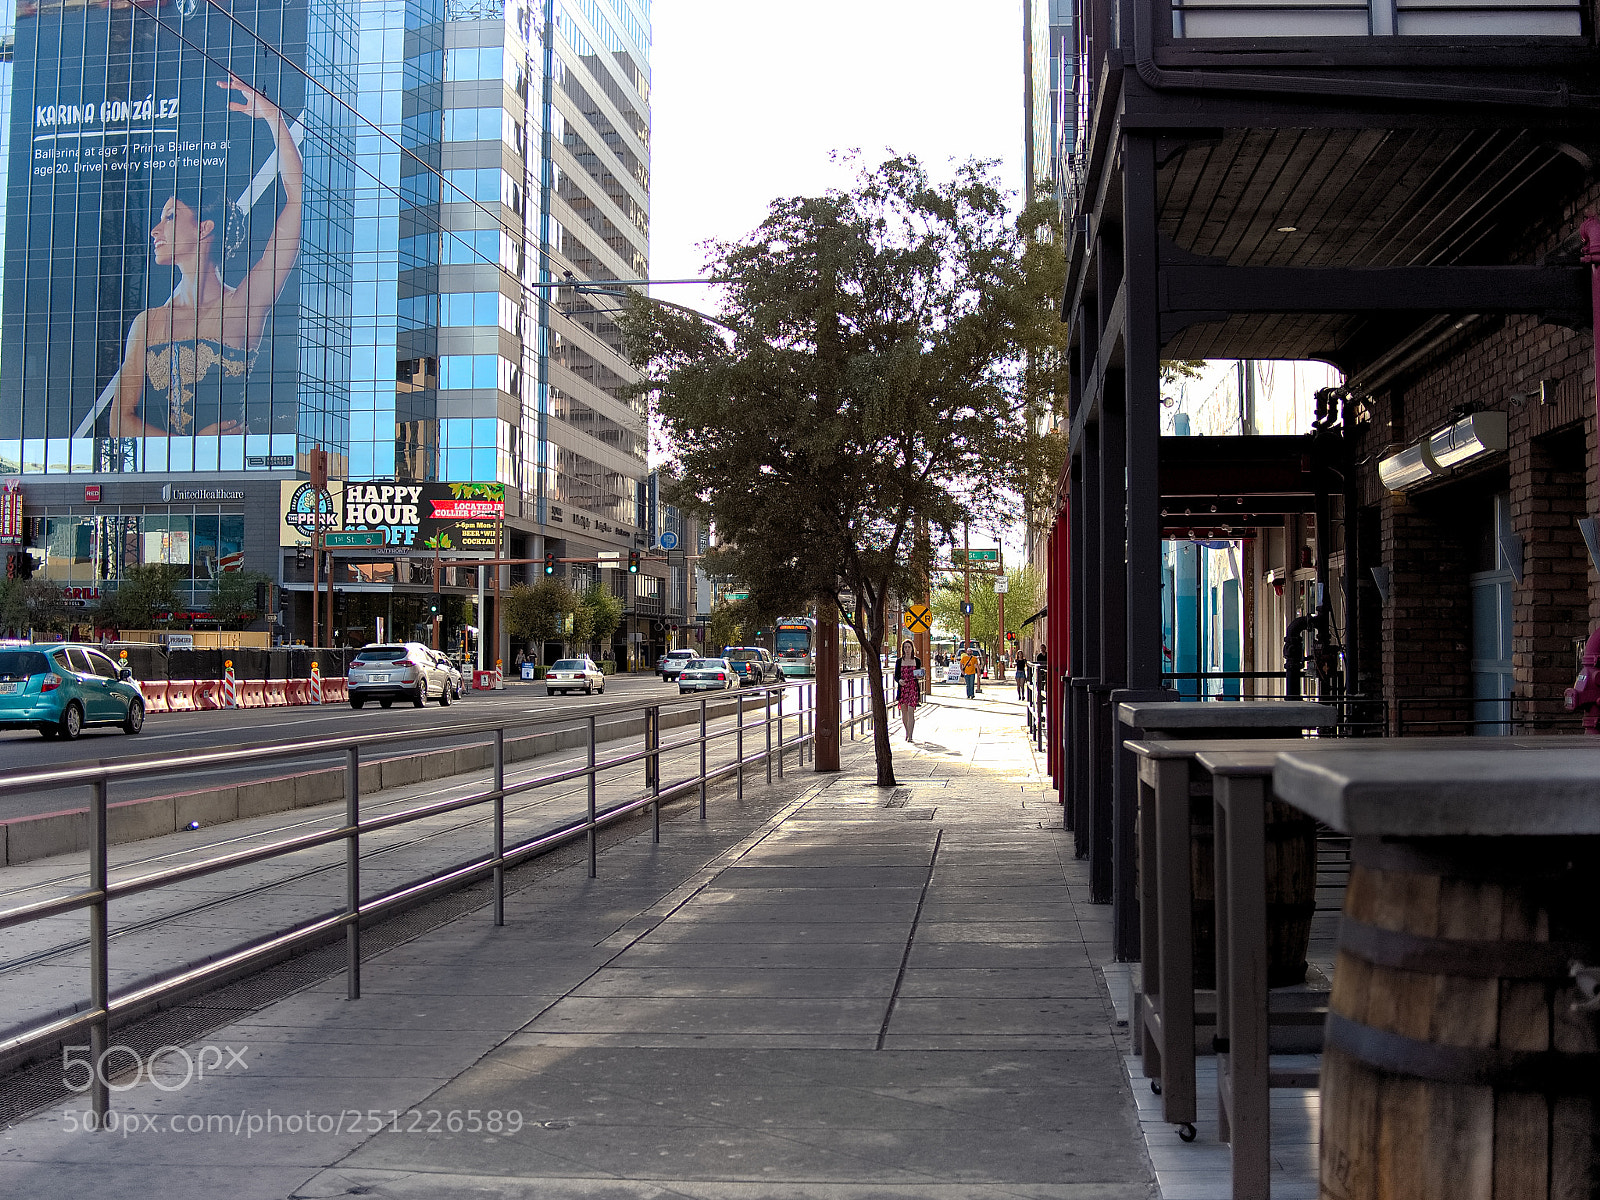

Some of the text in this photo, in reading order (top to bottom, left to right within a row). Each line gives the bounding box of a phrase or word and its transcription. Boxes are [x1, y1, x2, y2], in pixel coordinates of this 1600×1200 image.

[36, 103, 95, 128] KARINA
[35, 148, 80, 159] Ballerina
[84, 147, 95, 157] at
[98, 147, 118, 157] age
[133, 143, 165, 154] Prima
[168, 141, 217, 152] Ballerna
[220, 139, 231, 150] at
[34, 166, 53, 176] age
[55, 163, 71, 174] 20.
[74, 162, 108, 172] Driven
[110, 159, 141, 172] every
[183, 156, 200, 167] the
[173, 489, 245, 499] UnitedHealthcare
[347, 486, 423, 503] HAPPY
[298, 513, 337, 525] PARK
[346, 504, 420, 525] HOUR
[435, 509, 504, 517] COLLIER CENTR
[63, 587, 100, 600] GRILL
